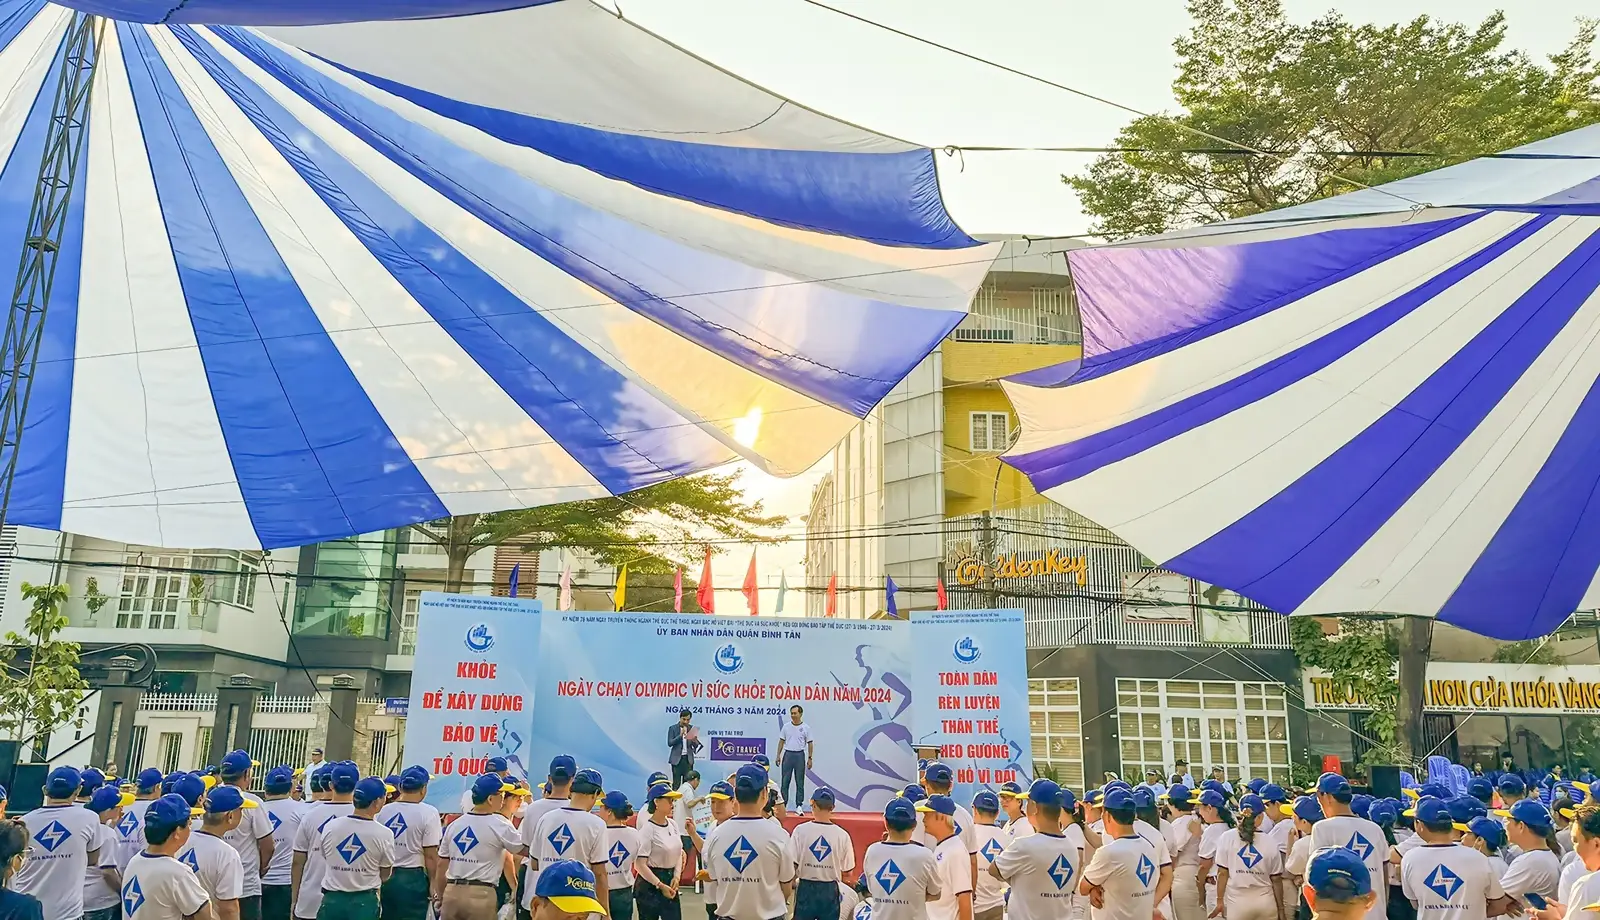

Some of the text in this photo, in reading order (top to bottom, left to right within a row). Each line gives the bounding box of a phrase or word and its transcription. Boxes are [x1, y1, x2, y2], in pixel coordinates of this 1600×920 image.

[656, 626, 668, 635] ỦY
[691, 627, 714, 636] NHÂN
[716, 628, 734, 637] DÂN
[736, 629, 759, 639] QUẬN
[761, 629, 782, 638] BÌNH
[784, 629, 800, 639] TÂN
[457, 658, 497, 679] KHỎE
[938, 670, 997, 686] TOÀN DÂN
[558, 677, 891, 703] NGÀY CHẠY OLYMPIC VÌ SỨC KHỎE TOÀN DÂN NĂM 2024
[1430, 680, 1469, 706] NON
[1470, 676, 1511, 707] CHÌA
[1511, 676, 1560, 708] KHÓA
[1559, 677, 1600, 708] VÀNG
[422, 686, 523, 714] ĐỂ XÂY DỰNG
[938, 693, 1000, 712] RÈN LUYỆN
[705, 705, 734, 714] THÁNG
[744, 706, 764, 715] NĂM
[442, 721, 498, 746] BẢO VỆ
[941, 715, 999, 733] THÂN THỂ
[940, 741, 1009, 759] HEO GƯƠNG
[433, 752, 489, 776] TỔ QUỐ
[957, 764, 974, 783] HỒ
